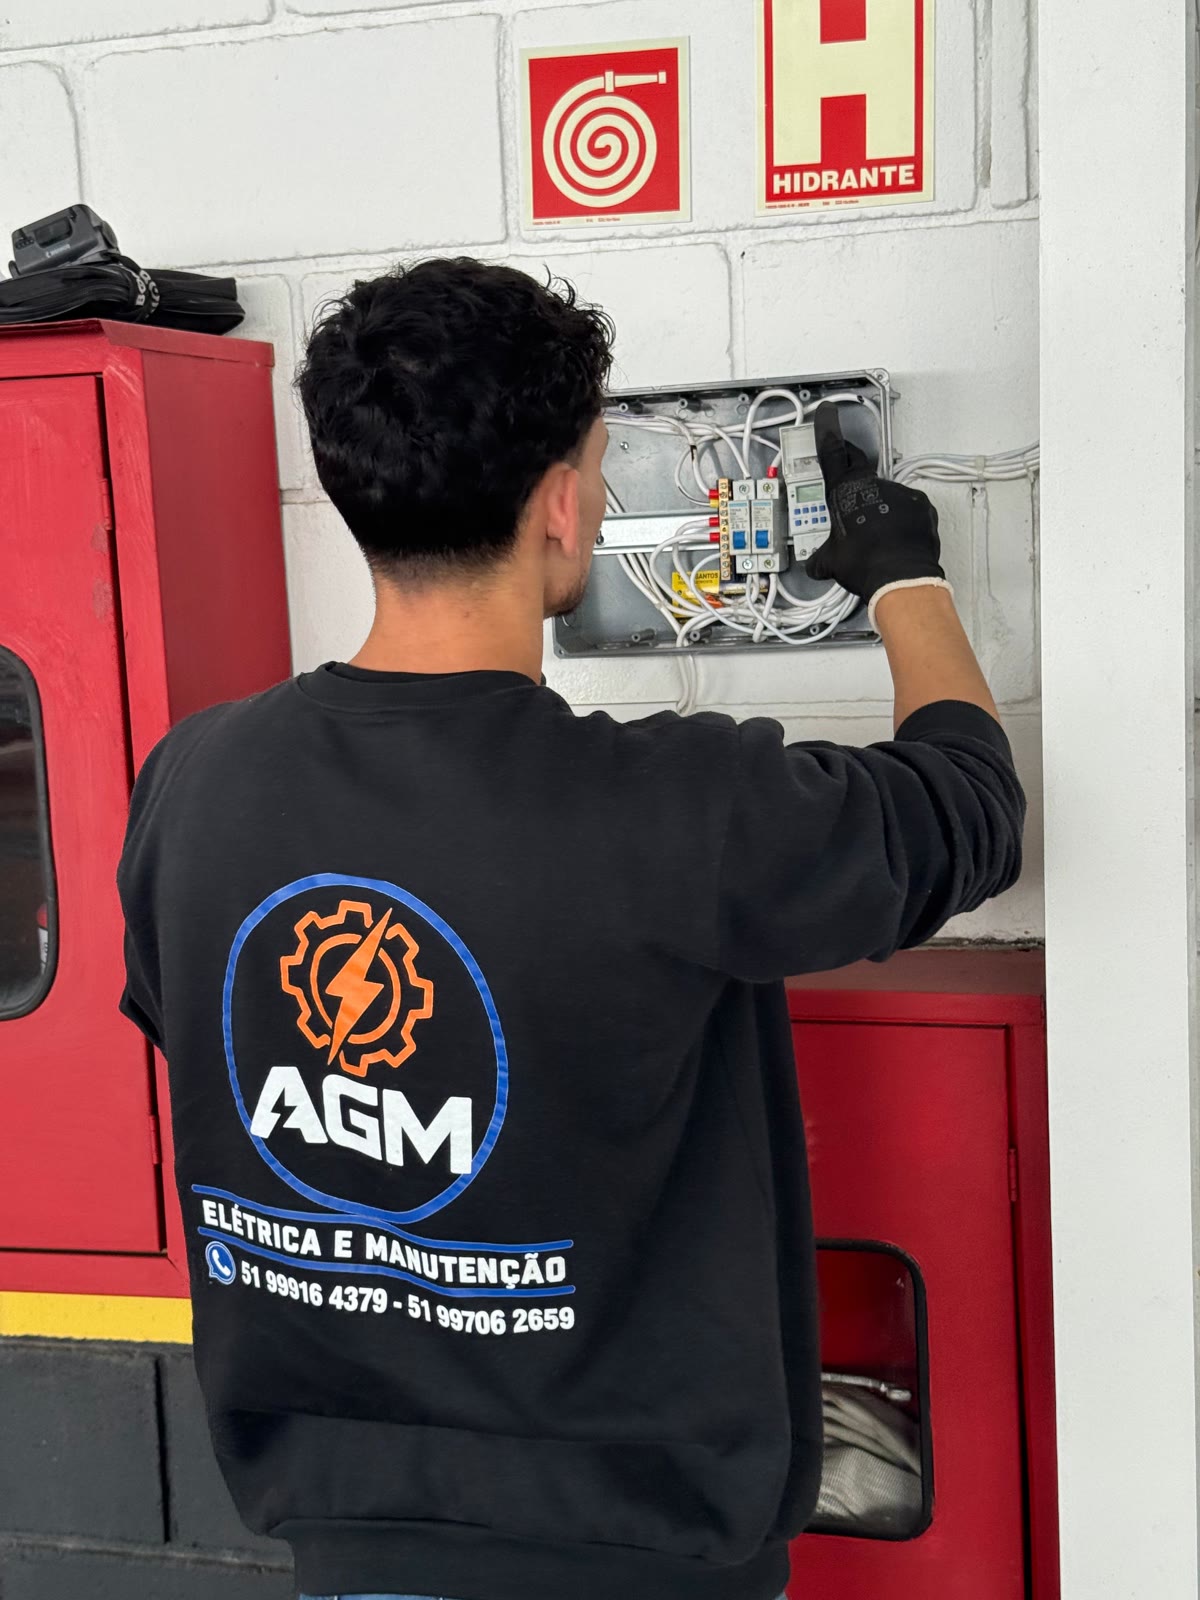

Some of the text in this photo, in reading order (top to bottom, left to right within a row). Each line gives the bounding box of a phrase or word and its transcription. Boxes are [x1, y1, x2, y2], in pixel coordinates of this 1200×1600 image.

[773, 0, 915, 167] H
[773, 164, 915, 195] HIDRANTE
[250, 1066, 472, 1174] AGM
[202, 1200, 566, 1289] ELÉTRICA E MANUTENÇÃO
[241, 1260, 260, 1288] 51
[266, 1269, 323, 1307] 99916
[329, 1285, 388, 1314] 4379
[408, 1294, 431, 1323] 51
[436, 1304, 506, 1336] 99706
[512, 1306, 575, 1334] 2659
